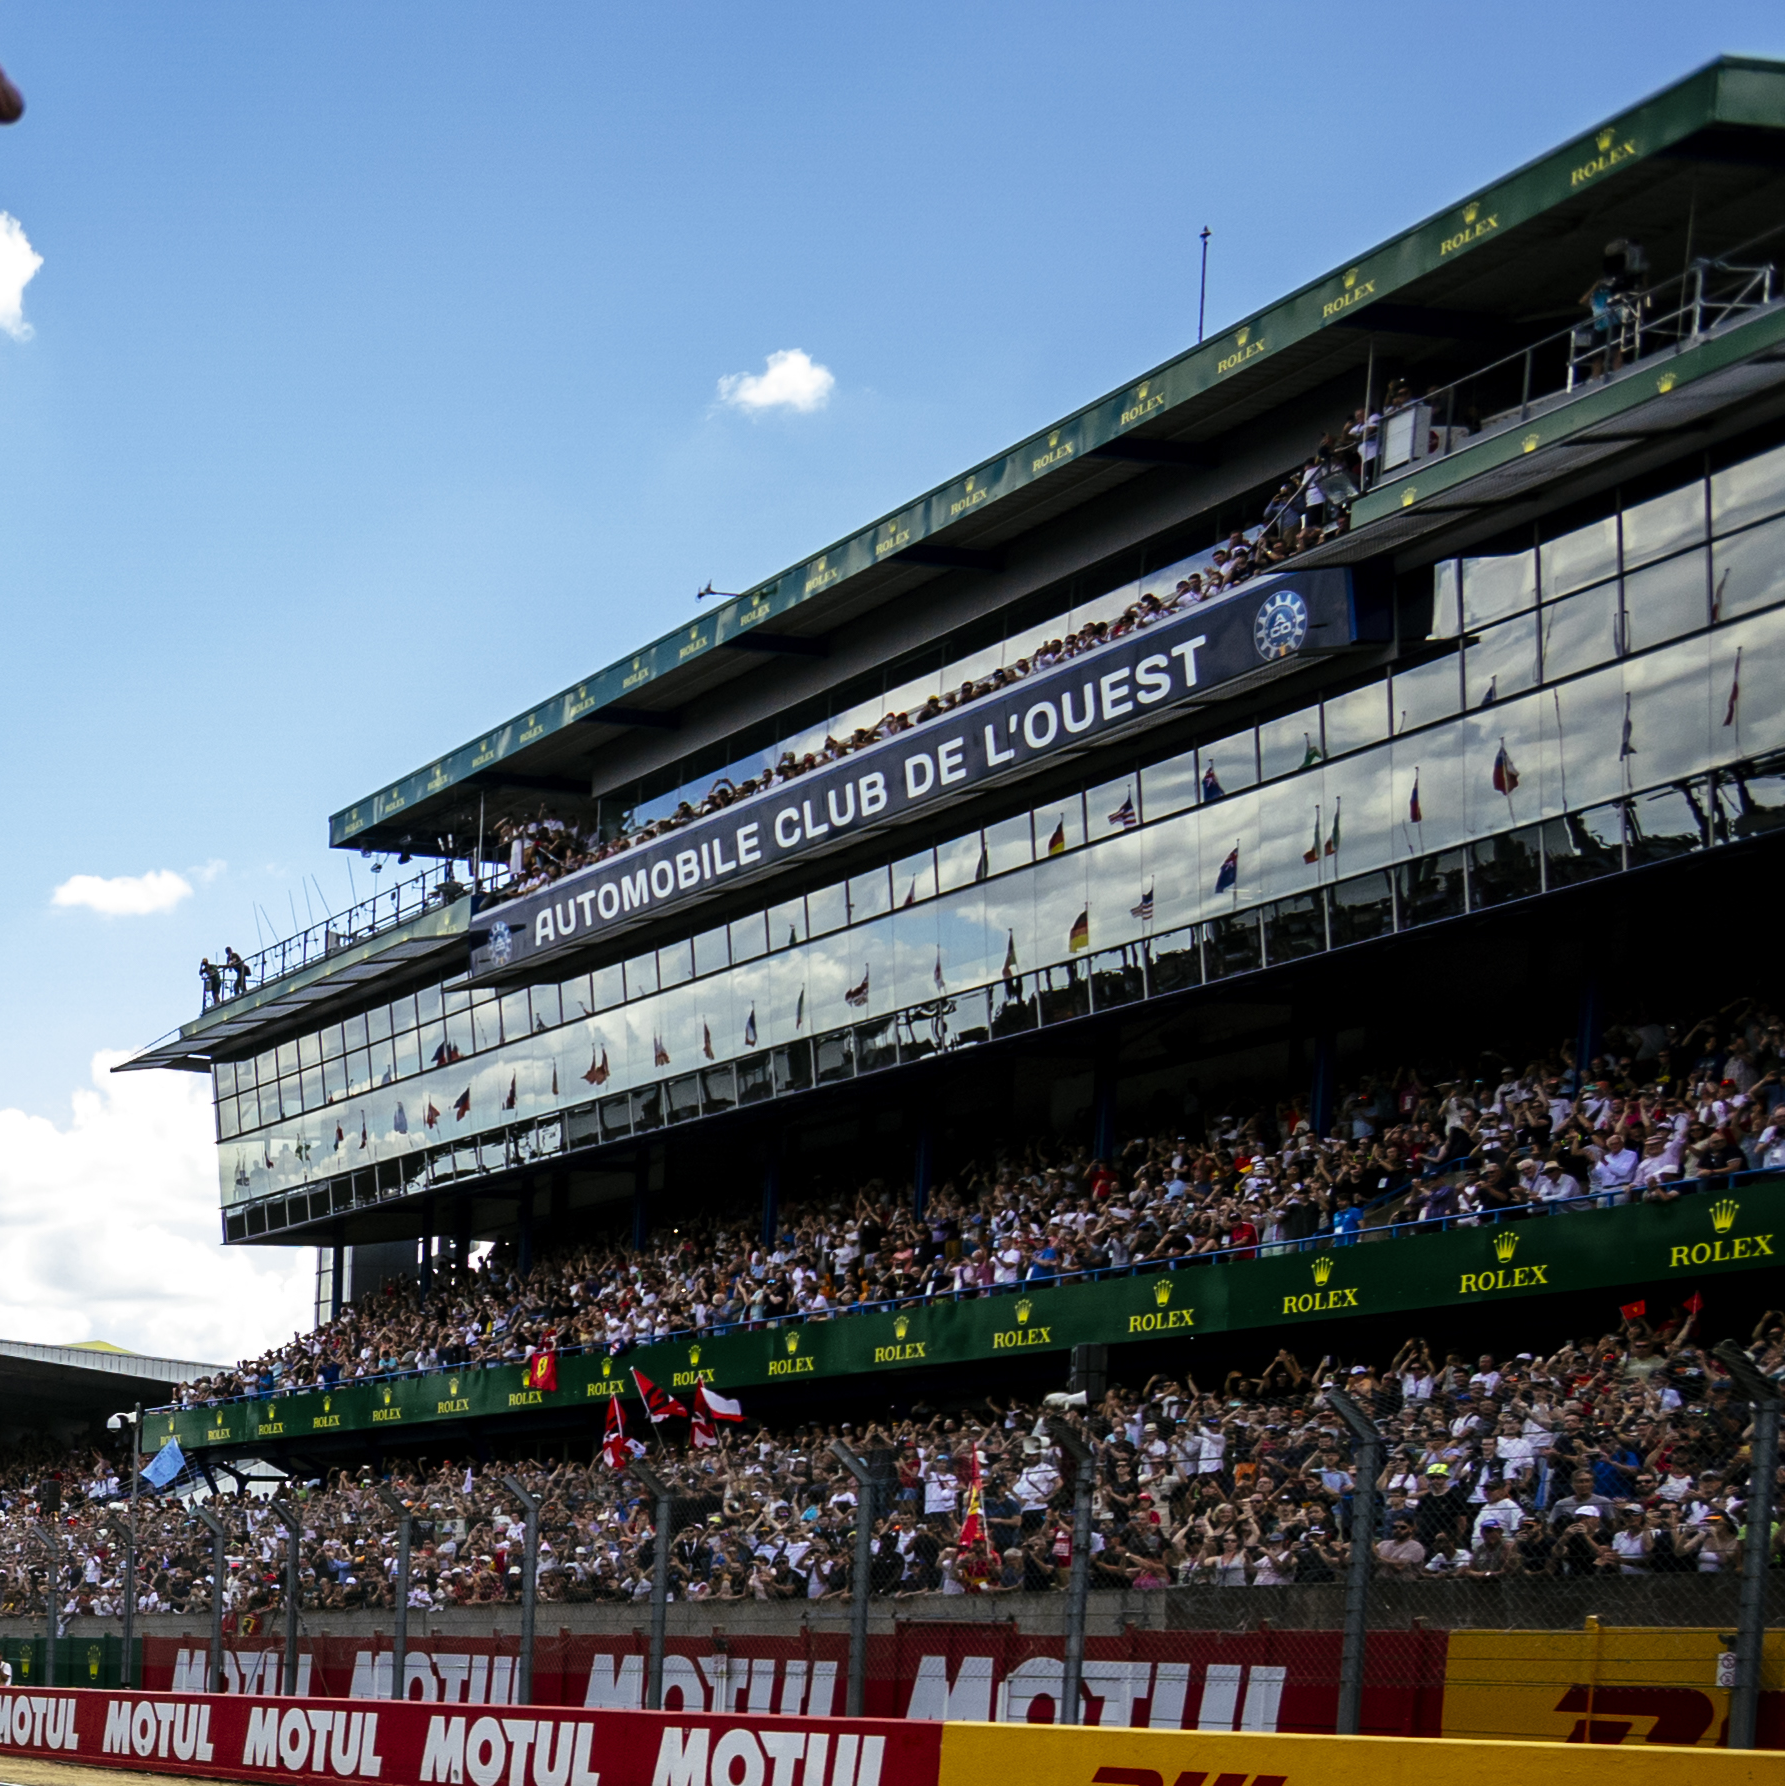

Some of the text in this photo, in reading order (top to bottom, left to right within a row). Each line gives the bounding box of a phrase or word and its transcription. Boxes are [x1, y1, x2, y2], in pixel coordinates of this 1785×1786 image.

[1570, 141, 1636, 186] ROLEX
[1440, 213, 1499, 255] ROLEX
[1322, 279, 1376, 318] ROLEX
[1216, 337, 1266, 374] ROLEX
[1119, 391, 1166, 426] ROLEX
[1031, 440, 1074, 472] ROLEX
[950, 485, 988, 516] ROLEX
[875, 528, 910, 556] ROLEX
[805, 566, 838, 592] ROLEX
[535, 635, 1206, 946] AUTOMOBILE CLUB DE L'OUEST
[1669, 1233, 1773, 1268] ROLEX
[1459, 1265, 1548, 1293] ROLEX
[1282, 1288, 1358, 1314] ROLEX
[1129, 1308, 1194, 1333] ROLEX
[993, 1326, 1051, 1349] ROLEX
[768, 1356, 814, 1376] ROLEX
[874, 1342, 926, 1363] ROLEX
[586, 1379, 625, 1397] ROLEX
[673, 1368, 715, 1387] ROLEX
[438, 1398, 469, 1413] ROLEX
[509, 1390, 543, 1406] ROLEX
[259, 1422, 283, 1435] ROLEX
[313, 1414, 341, 1428] ROLEX
[372, 1408, 401, 1422] ROLEX
[103, 1699, 214, 1763] MOTUL
[243, 1706, 383, 1778] MOTUL
